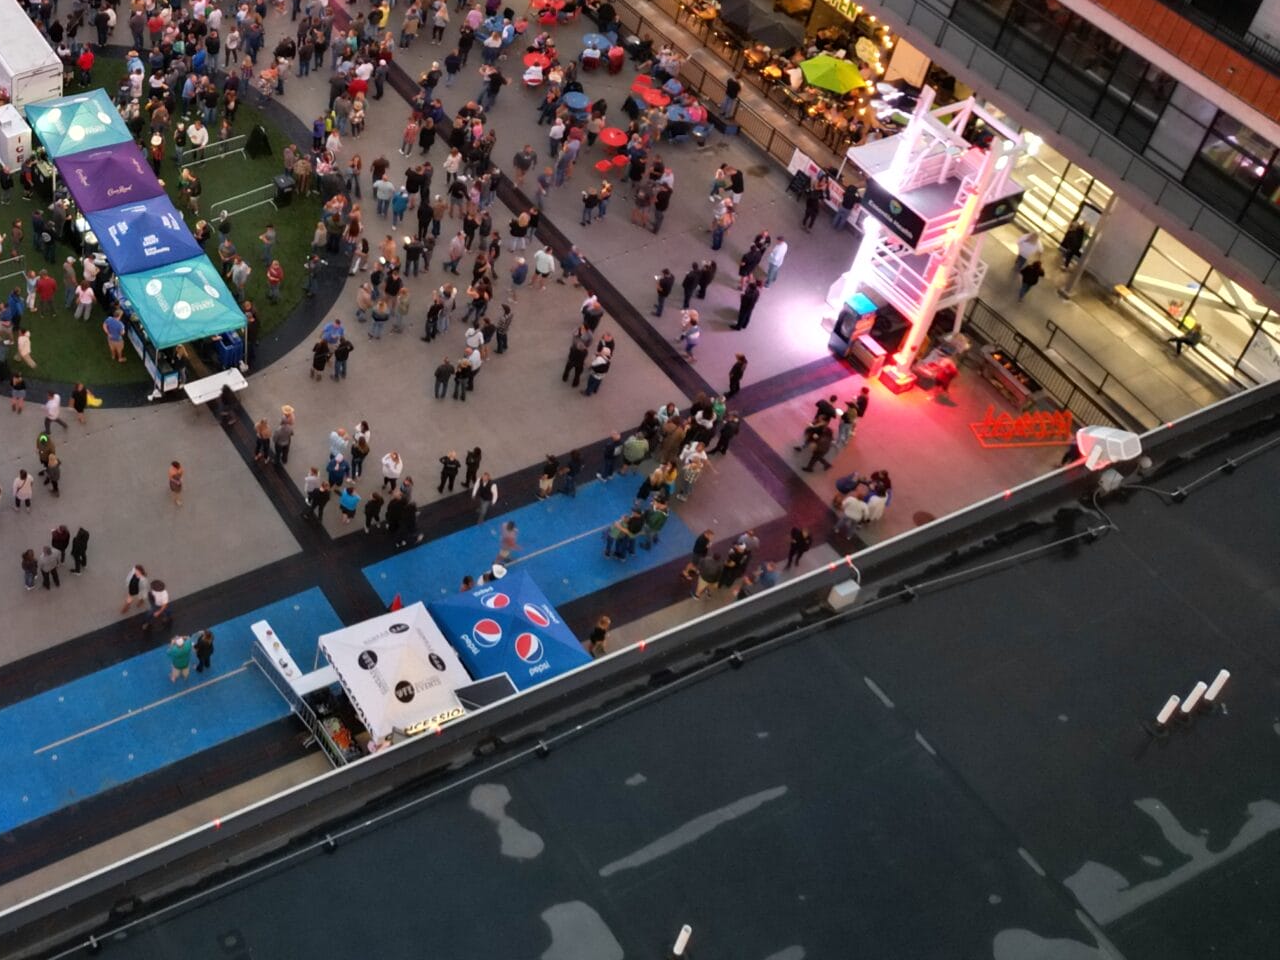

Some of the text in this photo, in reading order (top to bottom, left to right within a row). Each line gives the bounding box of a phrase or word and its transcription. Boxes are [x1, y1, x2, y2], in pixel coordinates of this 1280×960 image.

[15, 136, 25, 164] ICE
[461, 634, 480, 655] pepsi
[528, 660, 551, 677] pepsi
